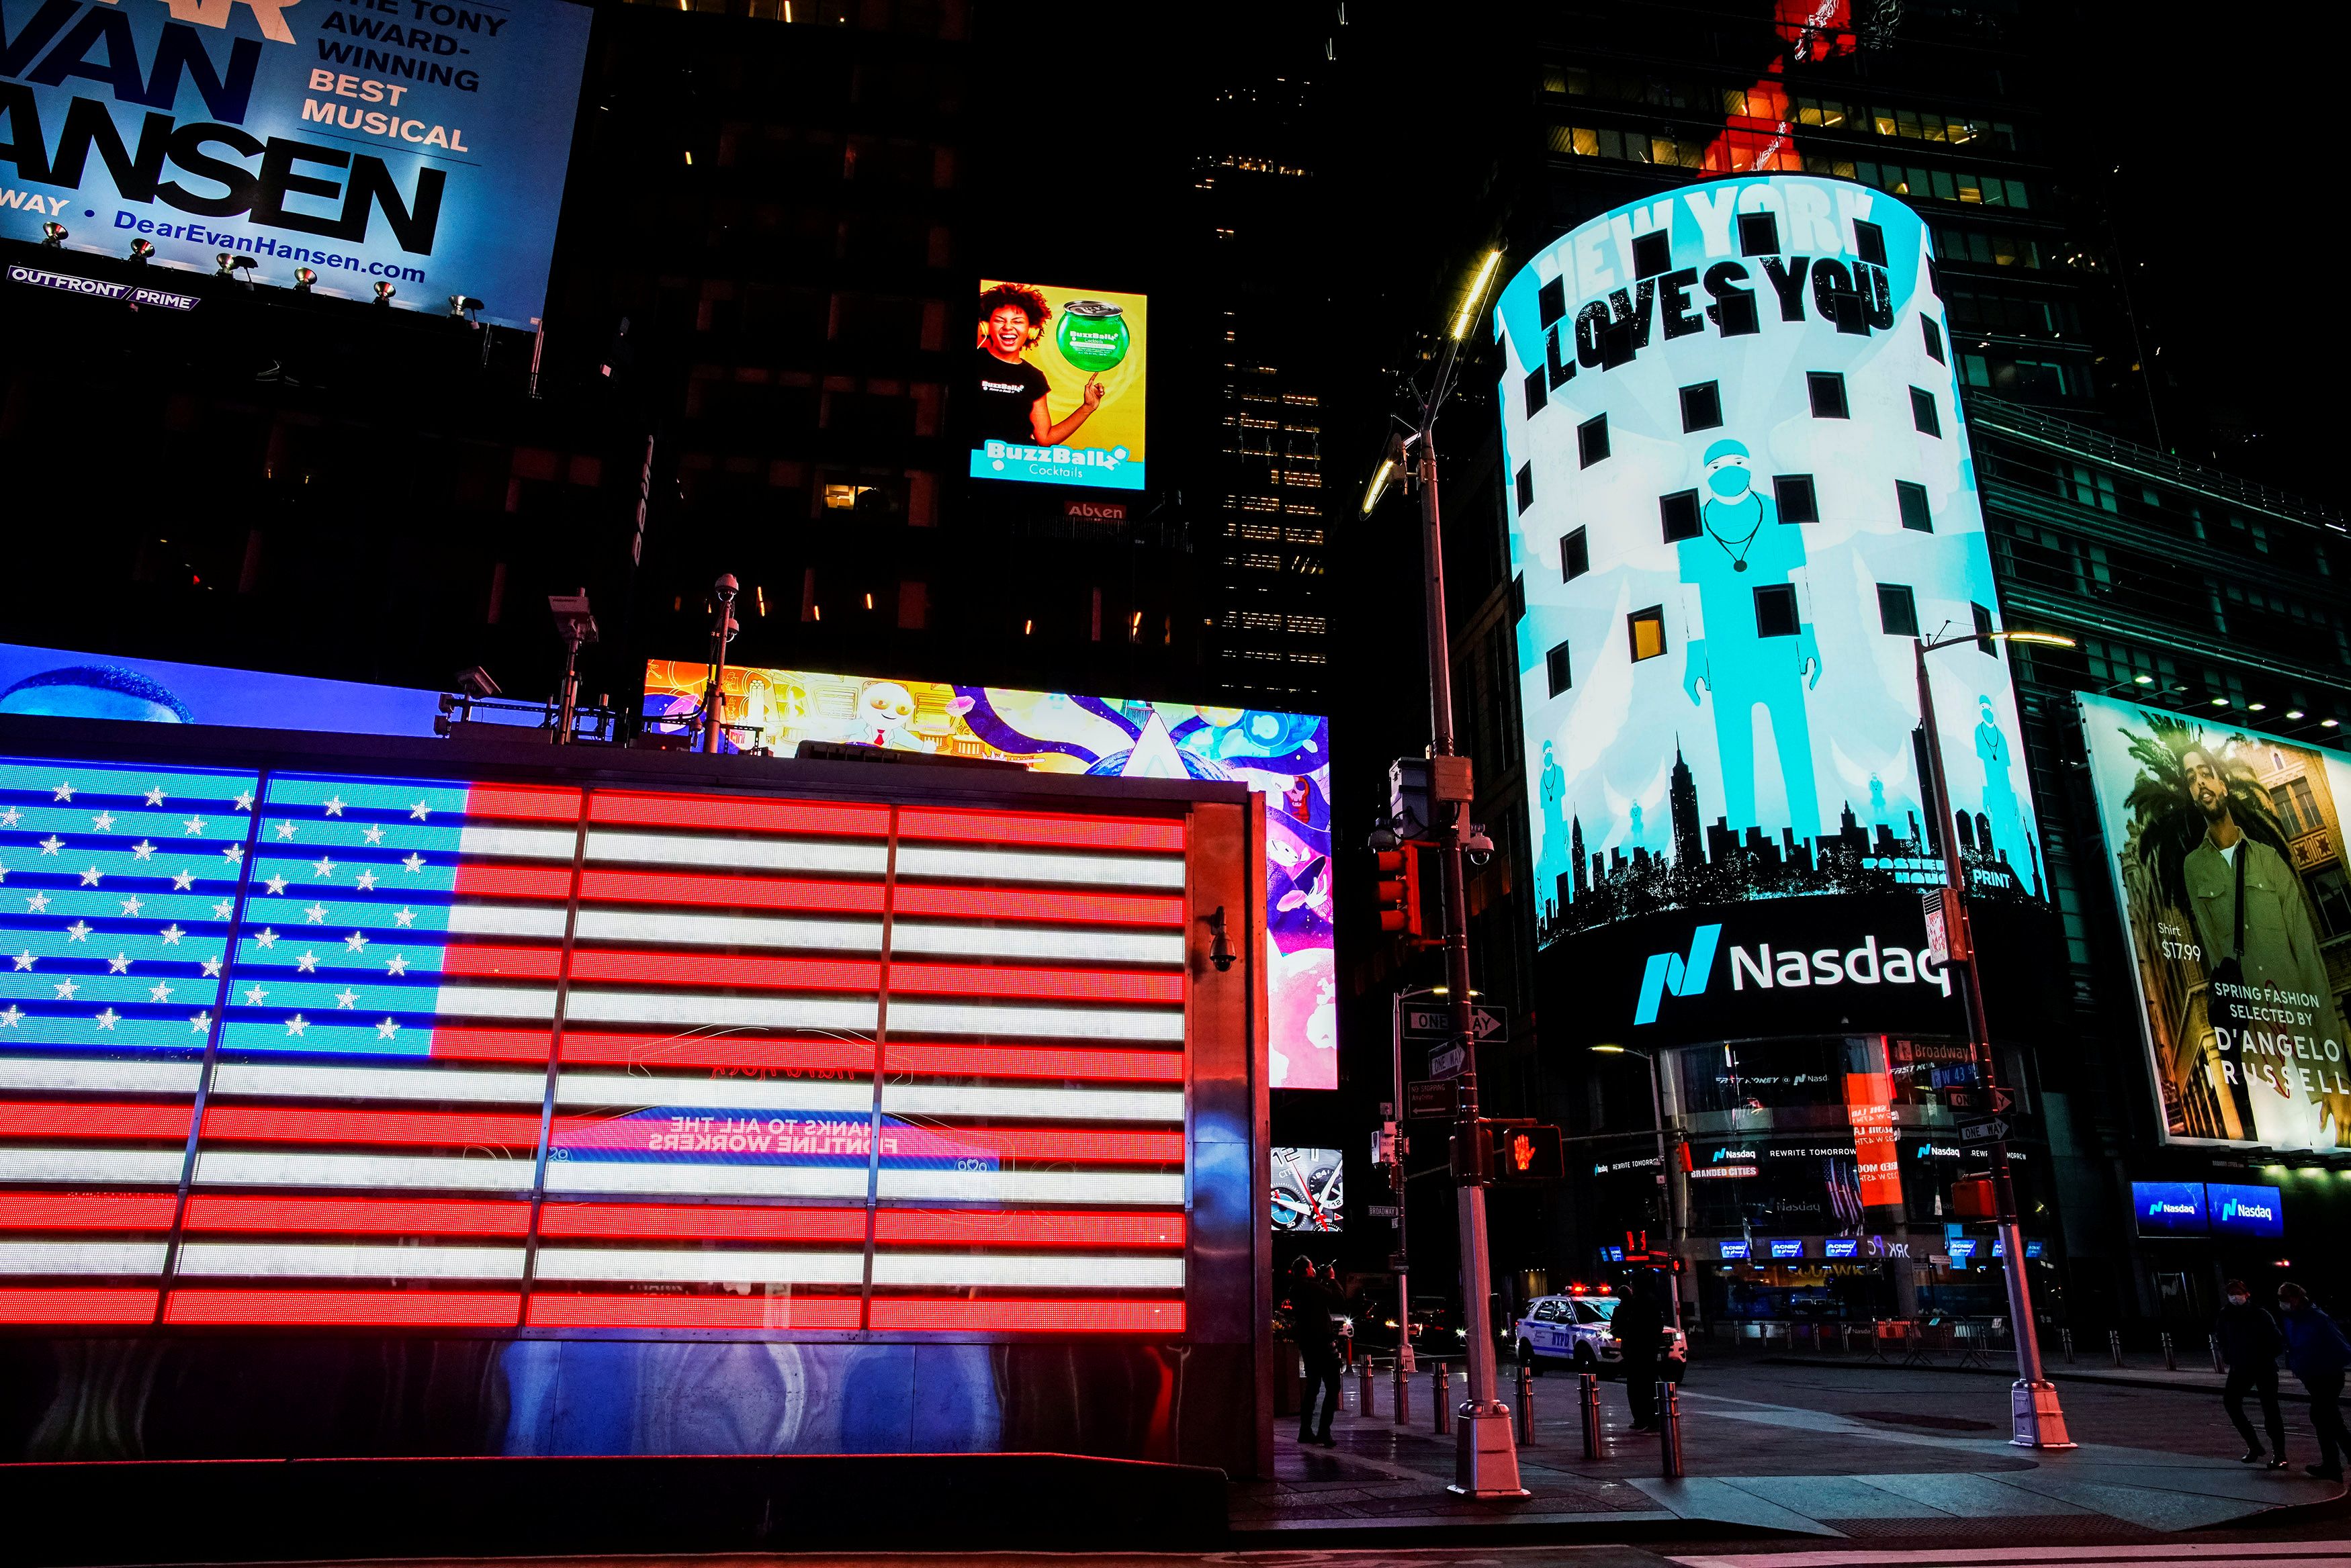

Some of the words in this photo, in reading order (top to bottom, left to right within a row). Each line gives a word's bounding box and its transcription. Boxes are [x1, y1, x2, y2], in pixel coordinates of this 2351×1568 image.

[411, 0, 508, 36] TONY
[321, 11, 470, 56] AWARD-
[318, 38, 480, 92] WINNING
[309, 68, 408, 107] BEST
[302, 98, 468, 152] MUSICAL
[0, 81, 447, 257] ANSEN
[0, 188, 70, 216] WAY
[114, 210, 425, 283] DearEvanHansen.com
[1538, 198, 1673, 308] NEW
[1683, 184, 1873, 257] YORK
[11, 269, 126, 298] OUTFRONT
[136, 290, 192, 310] PRIME
[1546, 261, 1755, 392] LOVES
[1759, 256, 1895, 334] YOU
[1029, 463, 1083, 478] Cocktails
[1896, 872, 1965, 886] HOUS
[1973, 869, 2010, 888] PRINT
[2158, 922, 2181, 936] Shirt
[2162, 939, 2201, 962] $17.99
[1730, 935, 1952, 998] Nasdaq
[2215, 982, 2262, 1001] SPRING
[2264, 988, 2319, 1008] FASHION
[1419, 1014, 1448, 1028] ONE
[1473, 1017, 1491, 1031] AY
[2230, 1004, 2295, 1025] SELECTED
[2299, 1013, 2312, 1026] BY
[1914, 1044, 1968, 1062] Broadway
[2214, 1027, 2340, 1062] D'ANGELO
[1435, 1057, 1446, 1072] ONE
[1450, 1048, 1462, 1065] WAY
[1941, 1068, 1950, 1084] W
[1955, 1067, 1965, 1082] 43
[2221, 1060, 2350, 1095] RUSSELL
[1965, 1127, 1981, 1138] ONE
[1986, 1122, 2003, 1135] WAY
[1632, 1156, 1663, 1167] TOMORR
[1726, 1150, 1755, 1158] Nasdaq
[1770, 1149, 1806, 1157] REWRITE
[1810, 1148, 1857, 1156] TOMORROW
[1931, 1148, 1960, 1158] Nasdaq
[1691, 1168, 1727, 1178] BRANDED
[1728, 1167, 1757, 1177] CITIES
[1369, 1207, 1394, 1215] BROADWAY
[2164, 1204, 2194, 1214] Nasdaq
[2237, 1203, 2272, 1221] Nasdaq
[1552, 1332, 1570, 1347] NYPD
